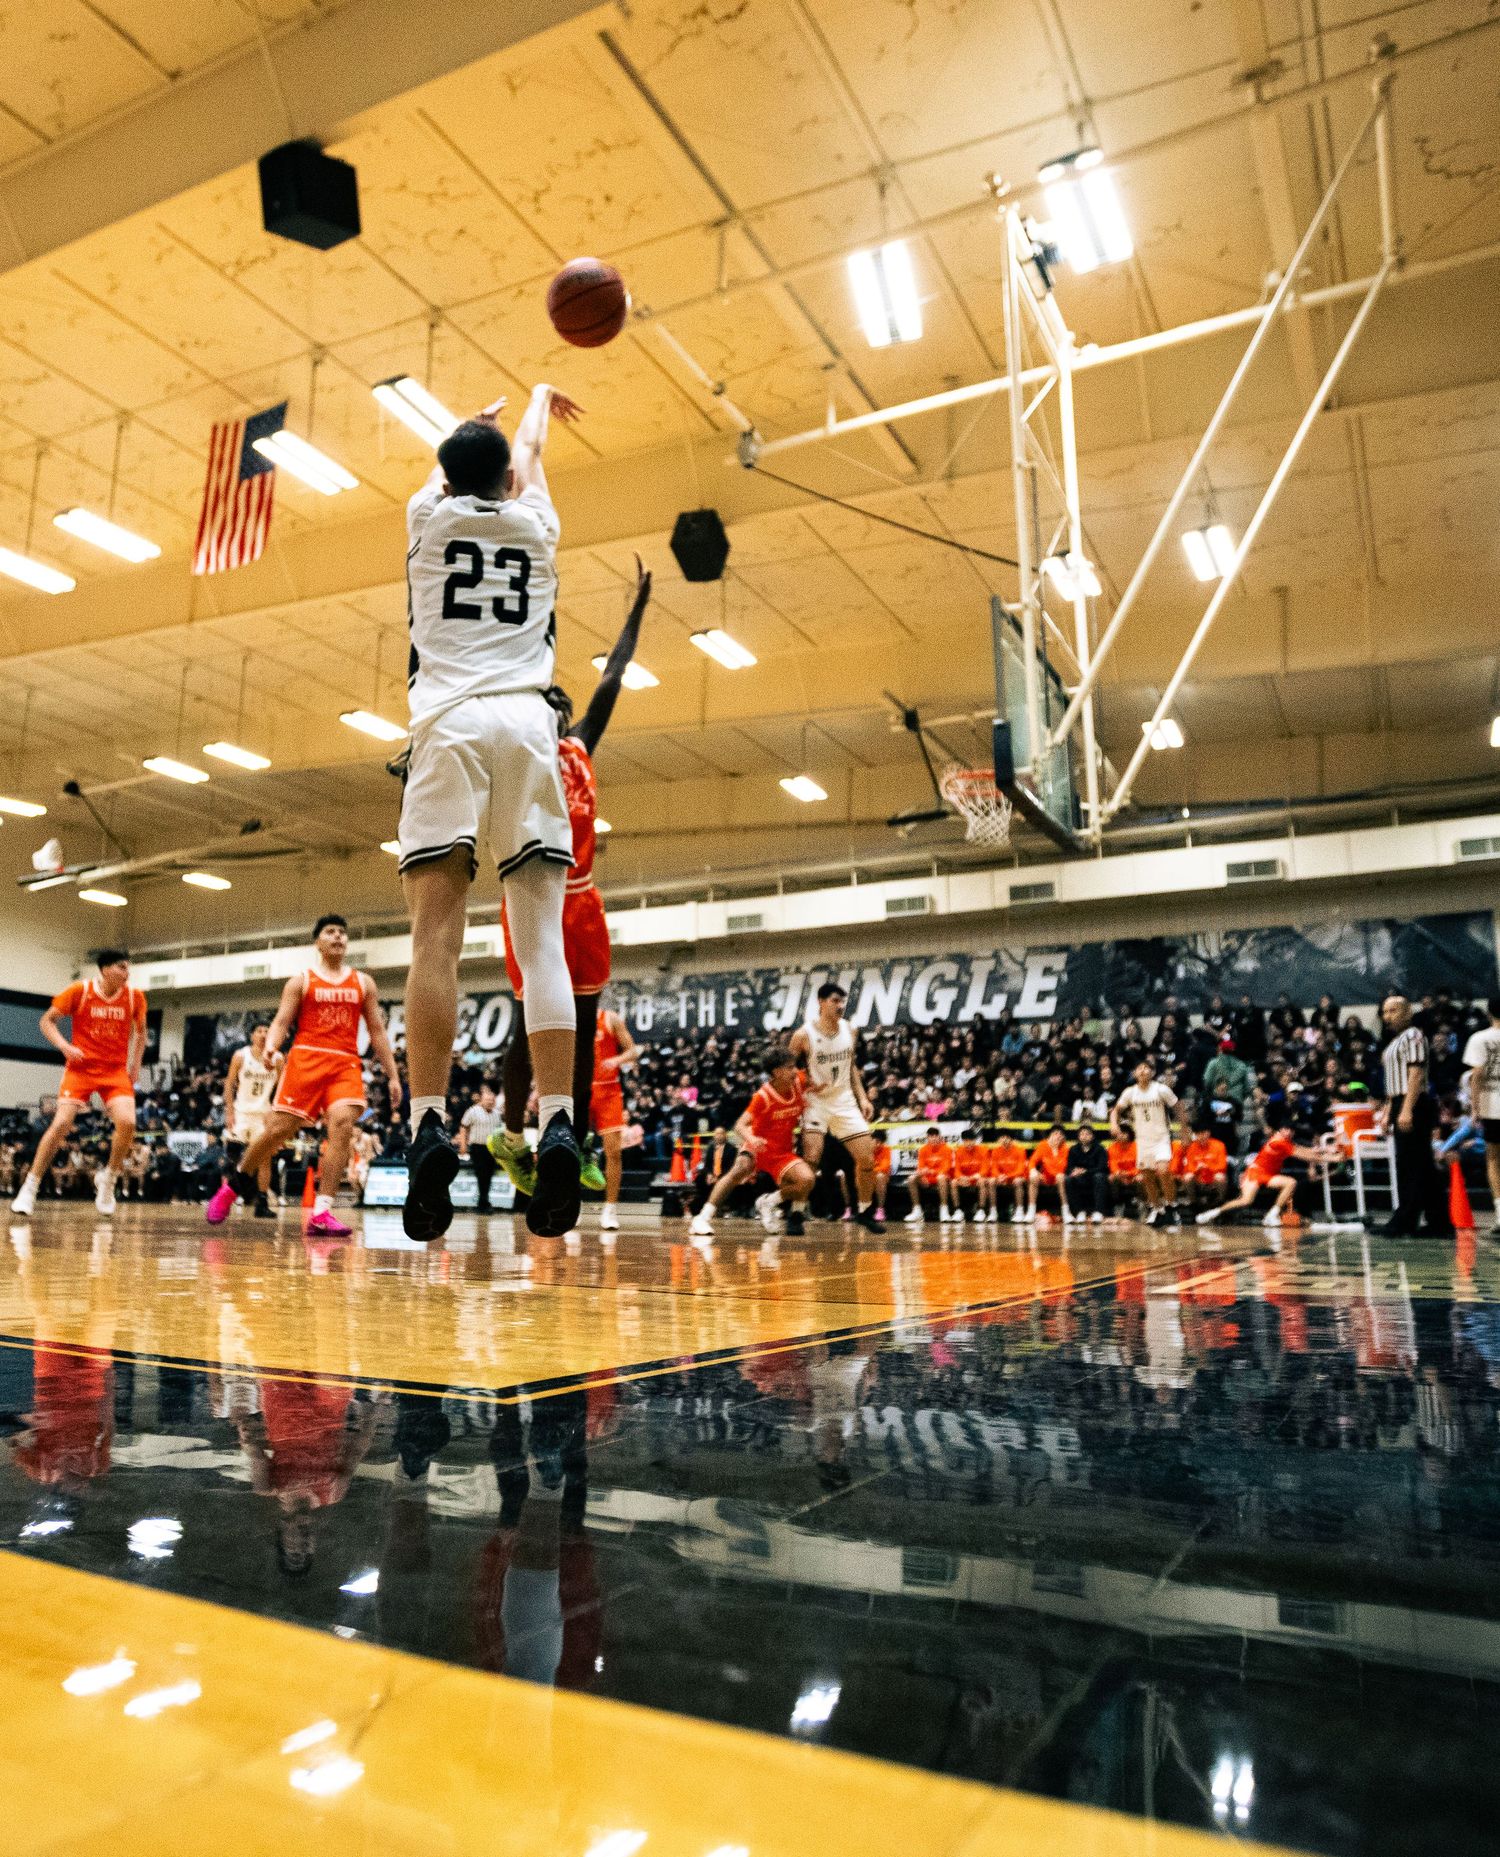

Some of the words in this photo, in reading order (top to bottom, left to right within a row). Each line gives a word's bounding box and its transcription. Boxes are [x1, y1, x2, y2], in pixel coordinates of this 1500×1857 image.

[442, 539, 532, 626] 23
[314, 987, 360, 1005] UNITED
[677, 987, 740, 1030] THE
